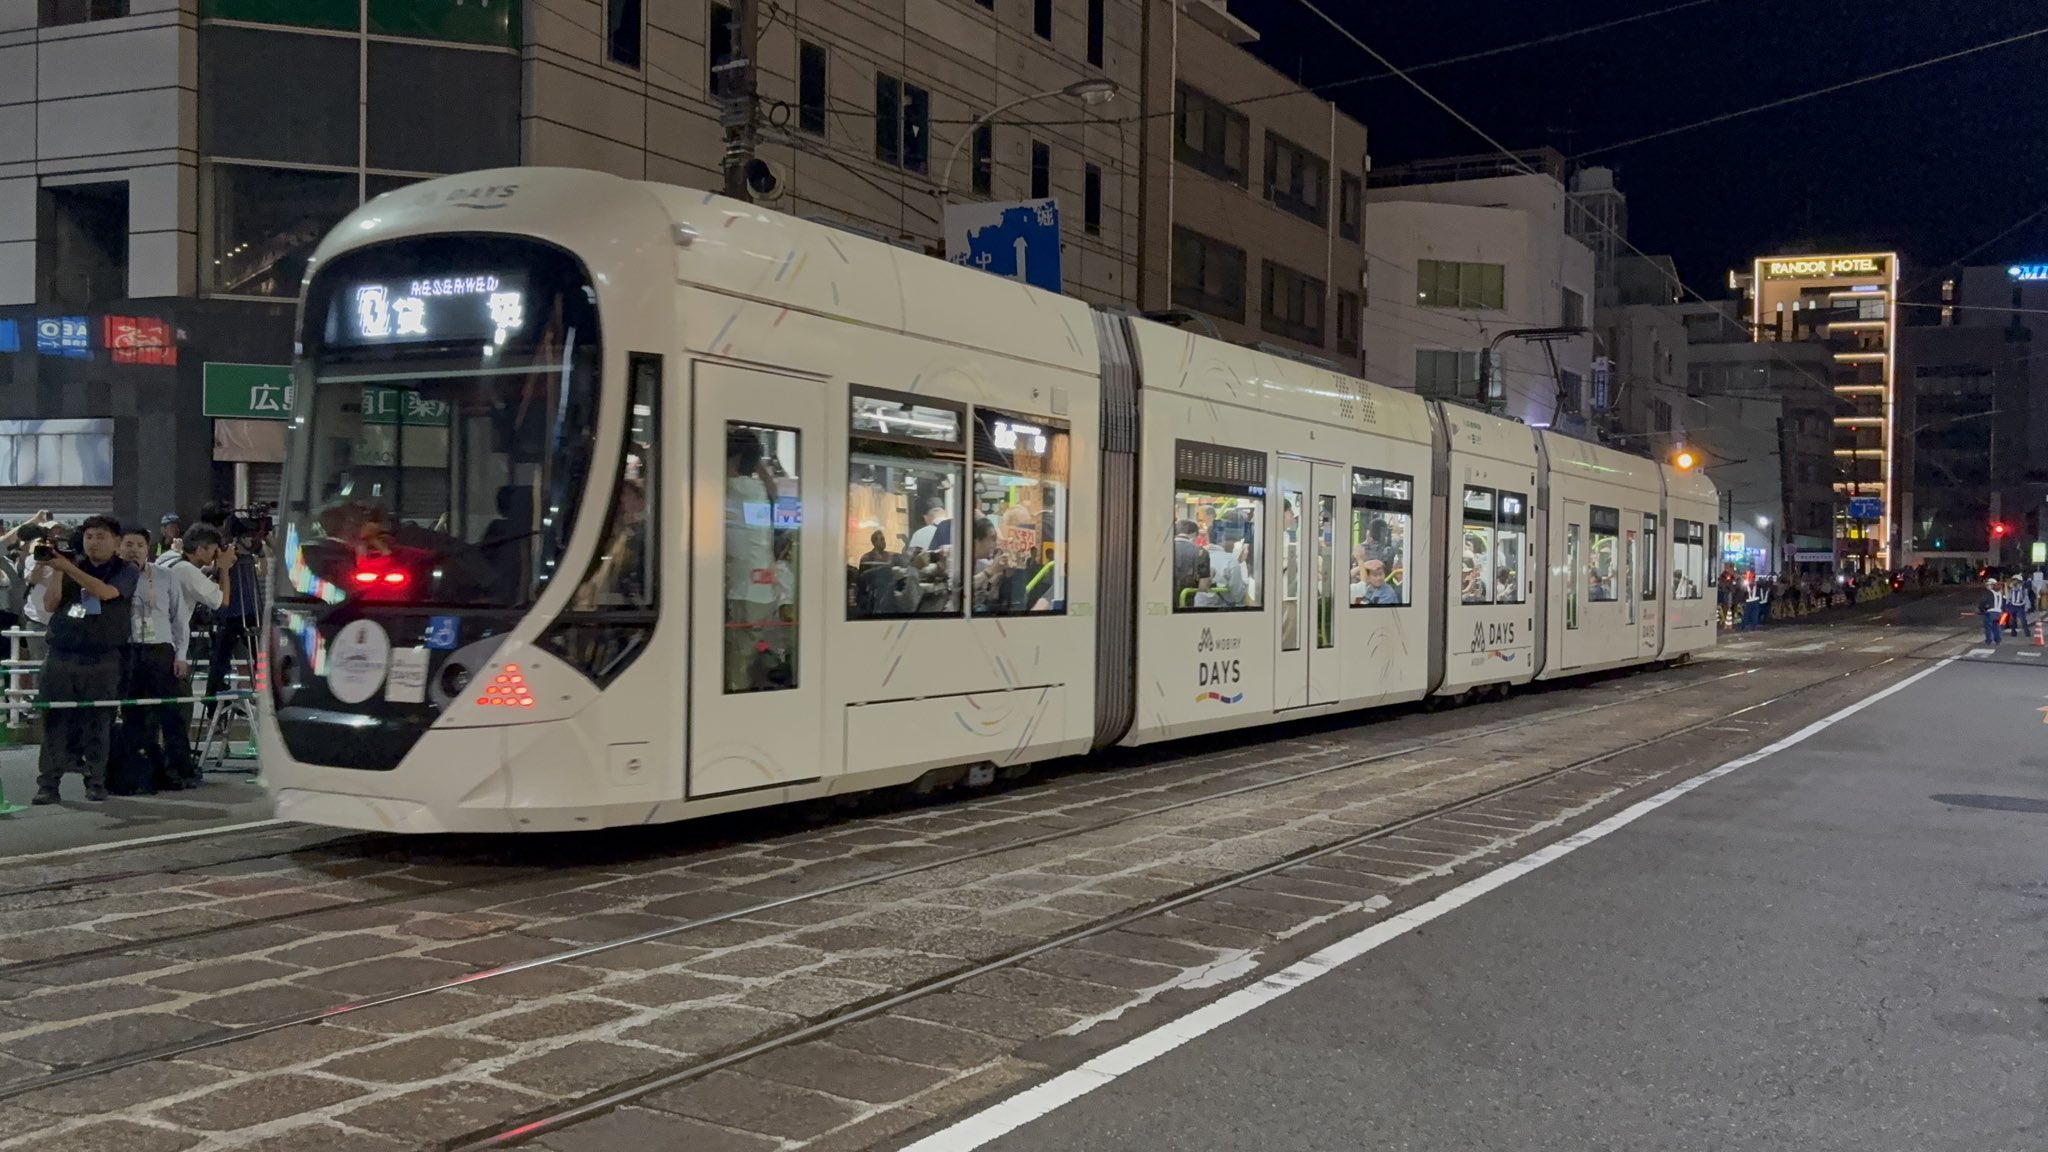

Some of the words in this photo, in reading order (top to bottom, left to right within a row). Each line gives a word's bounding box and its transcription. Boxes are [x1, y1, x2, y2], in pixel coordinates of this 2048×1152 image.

[1771, 261, 1826, 274] RANDOR
[1831, 259, 1878, 272] HOTEL
[1489, 622, 1514, 645] DAYS
[1199, 659, 1240, 686] DAYS
